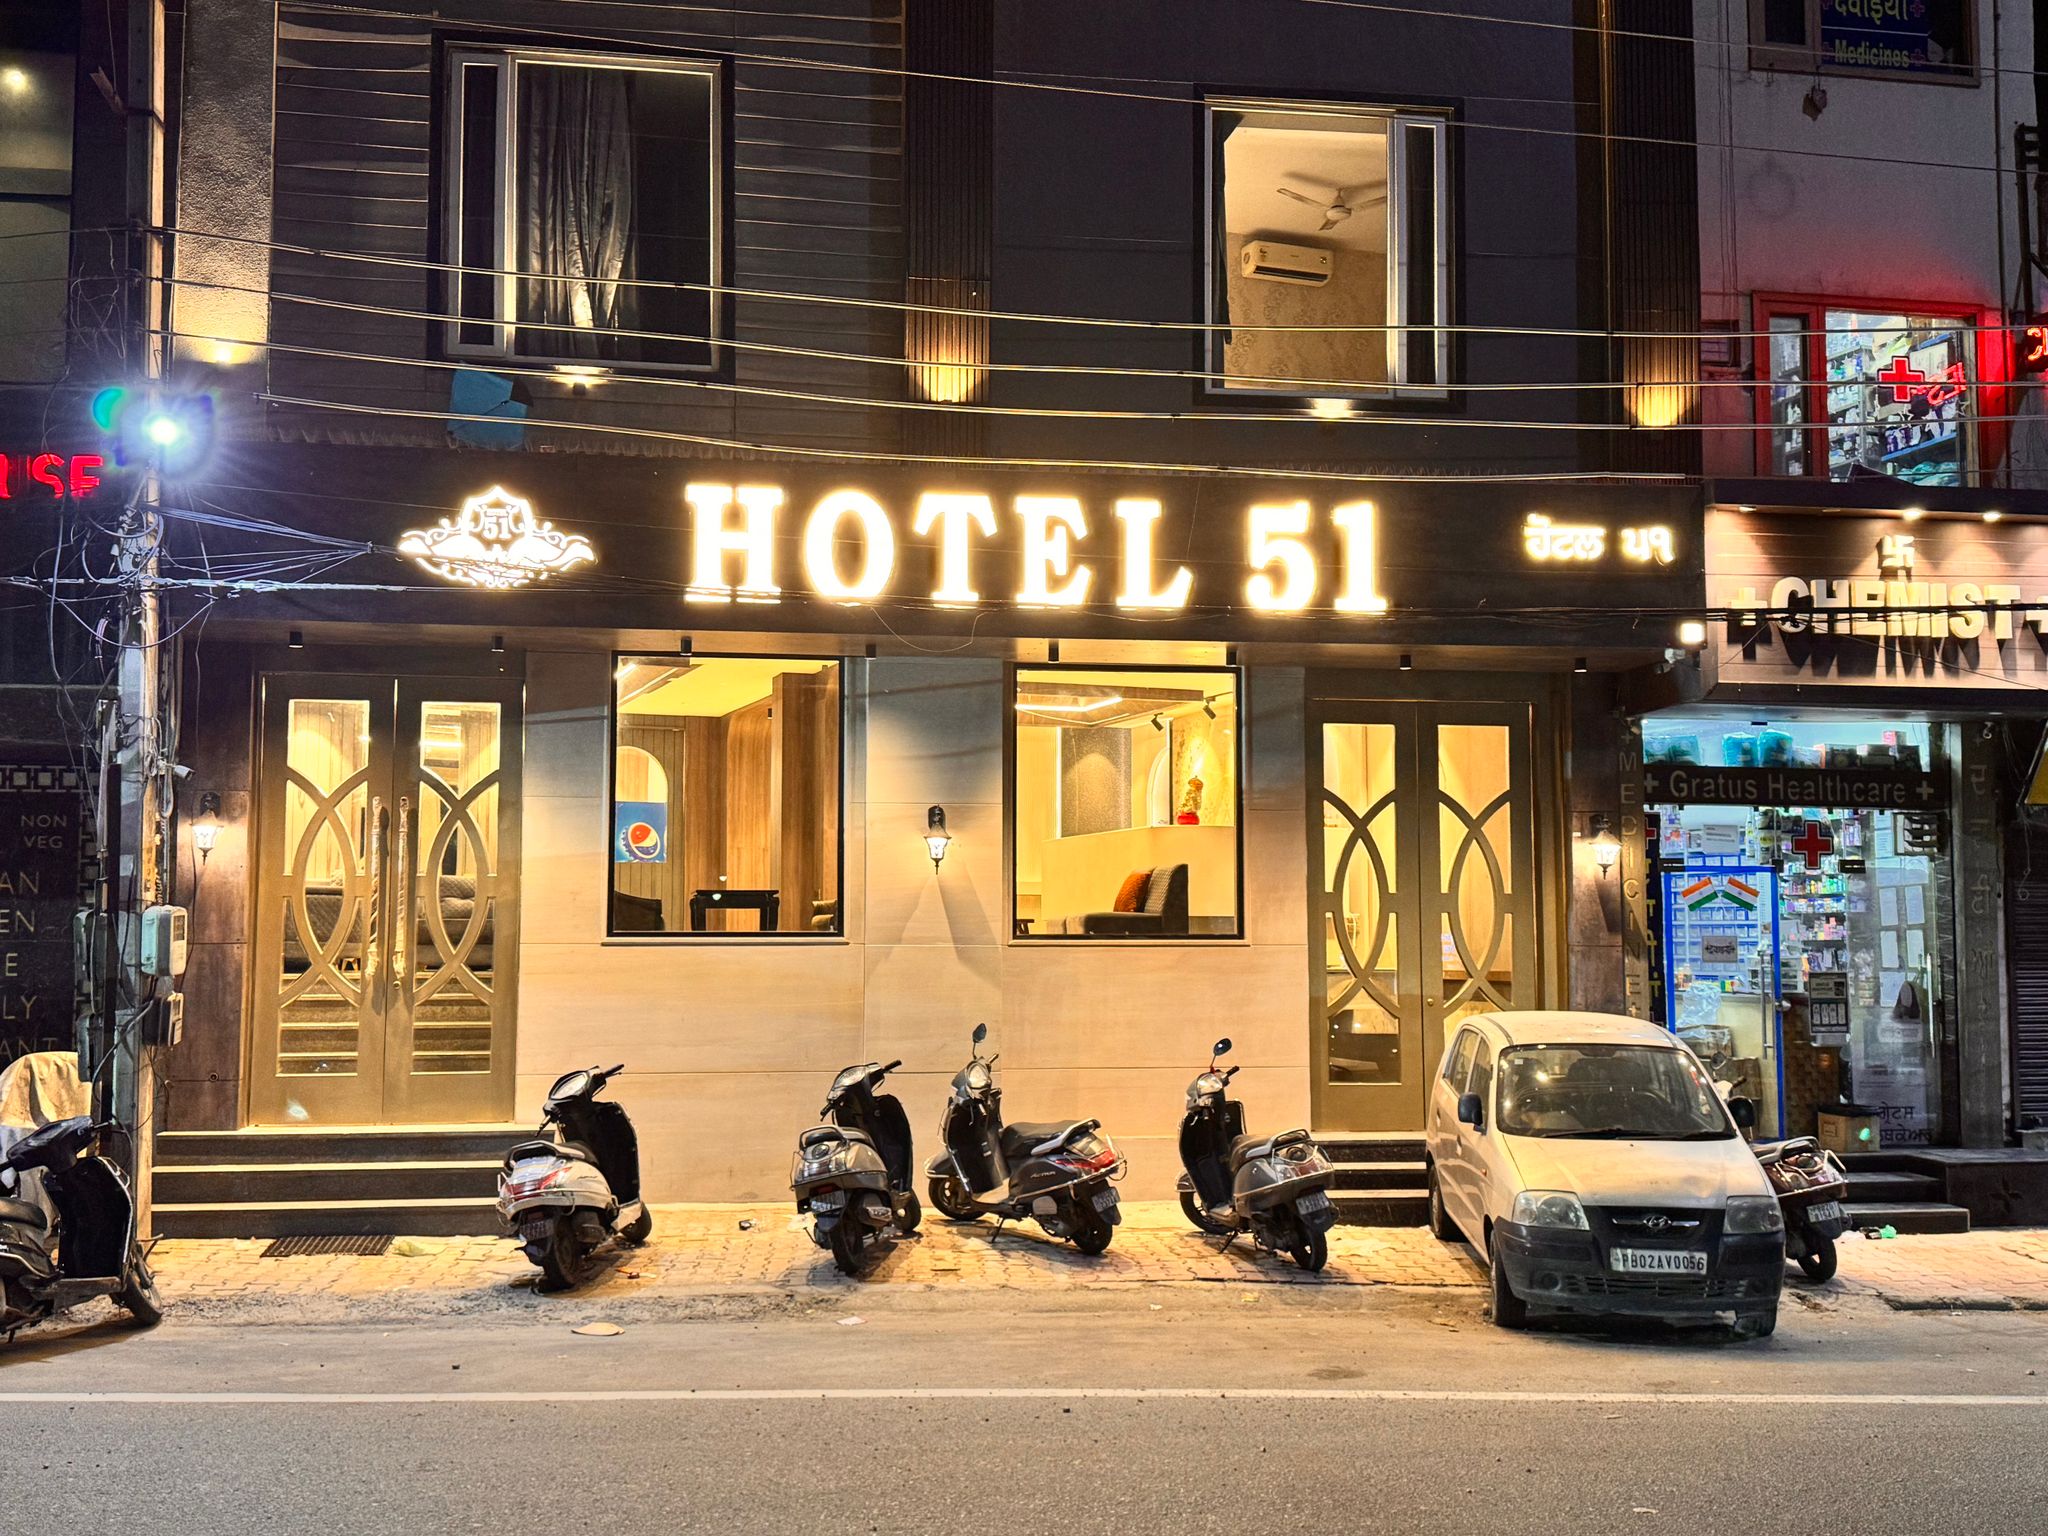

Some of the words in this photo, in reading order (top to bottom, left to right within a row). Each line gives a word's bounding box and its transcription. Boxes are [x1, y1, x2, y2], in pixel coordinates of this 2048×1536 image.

[1834, 39, 1911, 68] Medicines
[483, 515, 512, 540] 51
[684, 483, 1194, 611] HOTEL
[1245, 499, 1388, 616] 51
[1771, 576, 2021, 640] CHEMIST
[1669, 769, 1758, 800] Gratus
[1768, 773, 1907, 804] Healthcare
[20, 814, 68, 828] NON
[24, 835, 64, 849] VEG
[1619, 751, 1641, 997] MEDICINE
[1622, 1253, 1705, 1271] PB02AV0056
